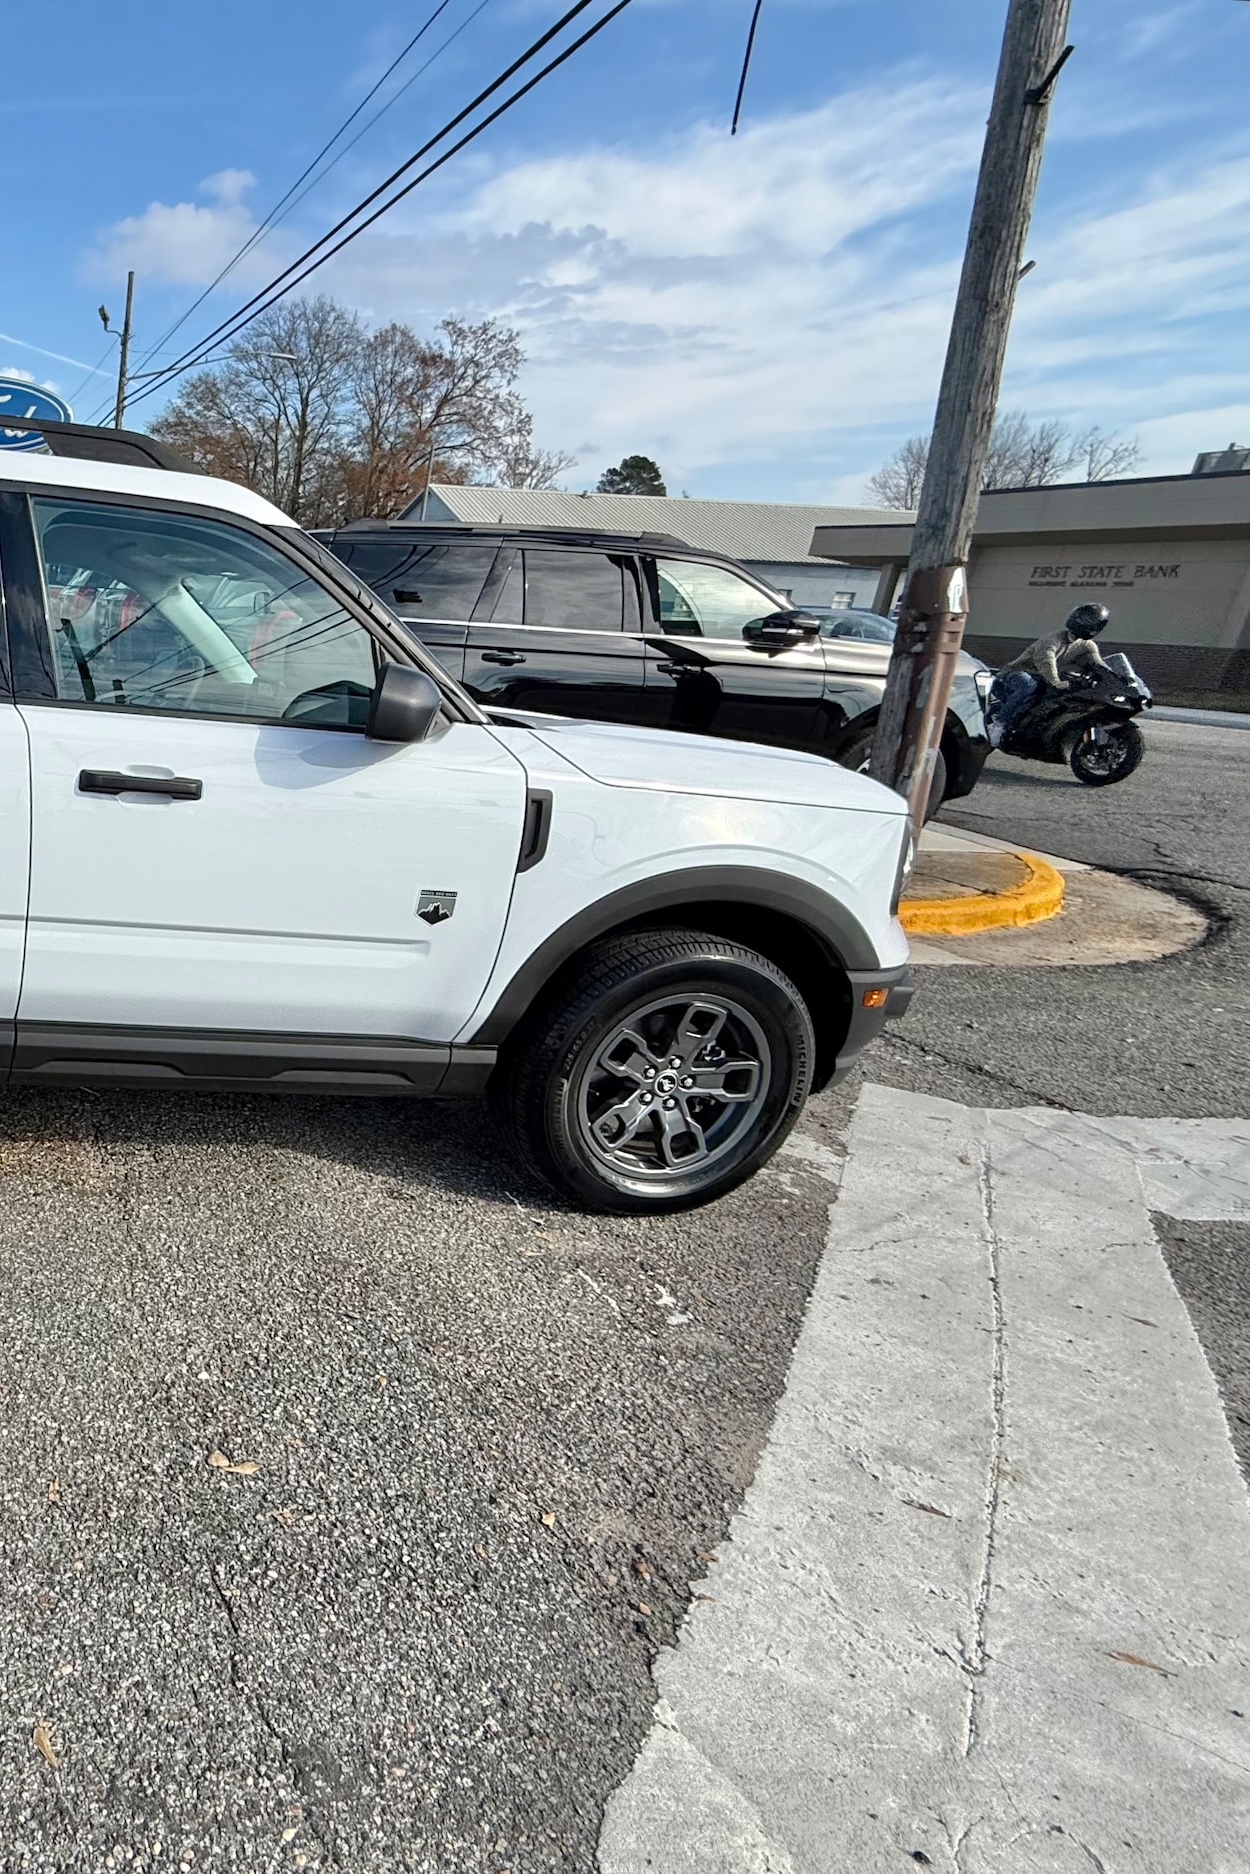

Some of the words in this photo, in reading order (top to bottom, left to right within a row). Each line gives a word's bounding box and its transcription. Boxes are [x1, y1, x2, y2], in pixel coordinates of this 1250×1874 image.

[1030, 565, 1072, 579] FIRST
[1077, 565, 1127, 579] STATE
[1133, 564, 1182, 578] BANK
[793, 1033, 807, 1104] MICHELIN
